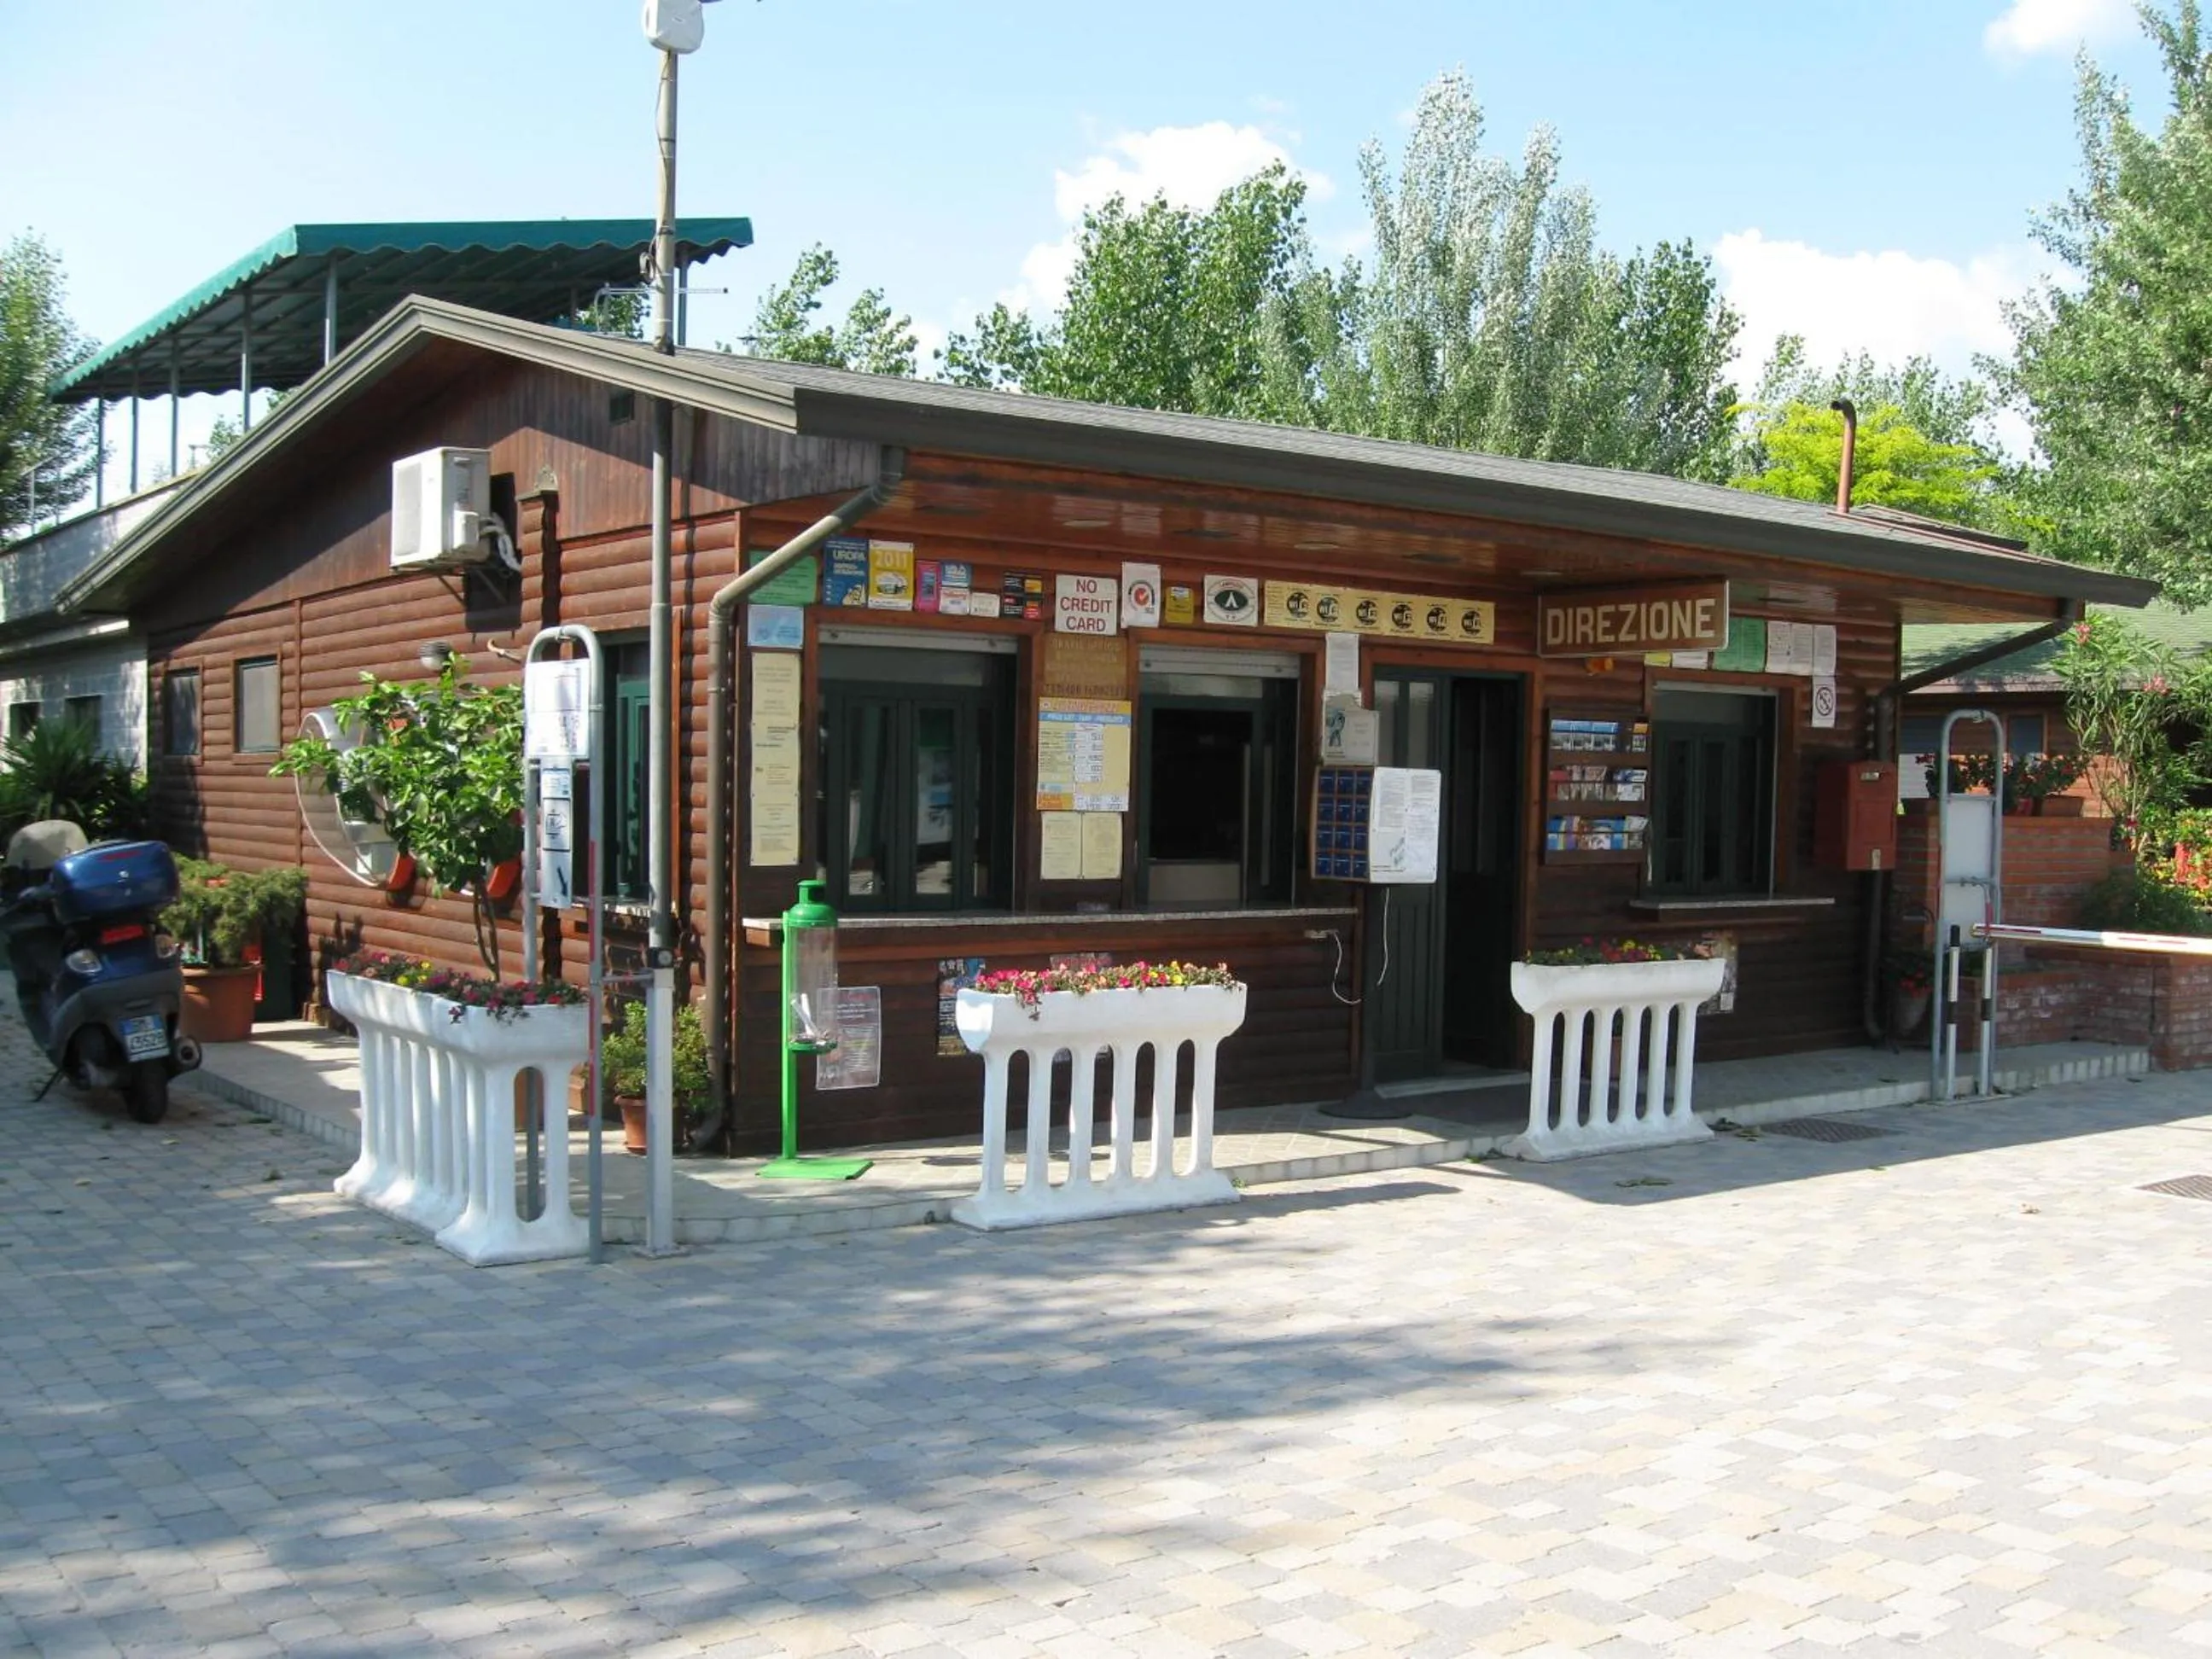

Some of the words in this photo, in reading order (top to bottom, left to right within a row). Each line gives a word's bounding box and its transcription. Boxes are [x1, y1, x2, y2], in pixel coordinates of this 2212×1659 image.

[876, 550, 908, 568] 2011
[1075, 579, 1097, 594] NO
[1060, 597, 1114, 614] CREDIT
[1067, 616, 1106, 632] CARD
[1546, 598, 1716, 645] DIREZIONE
